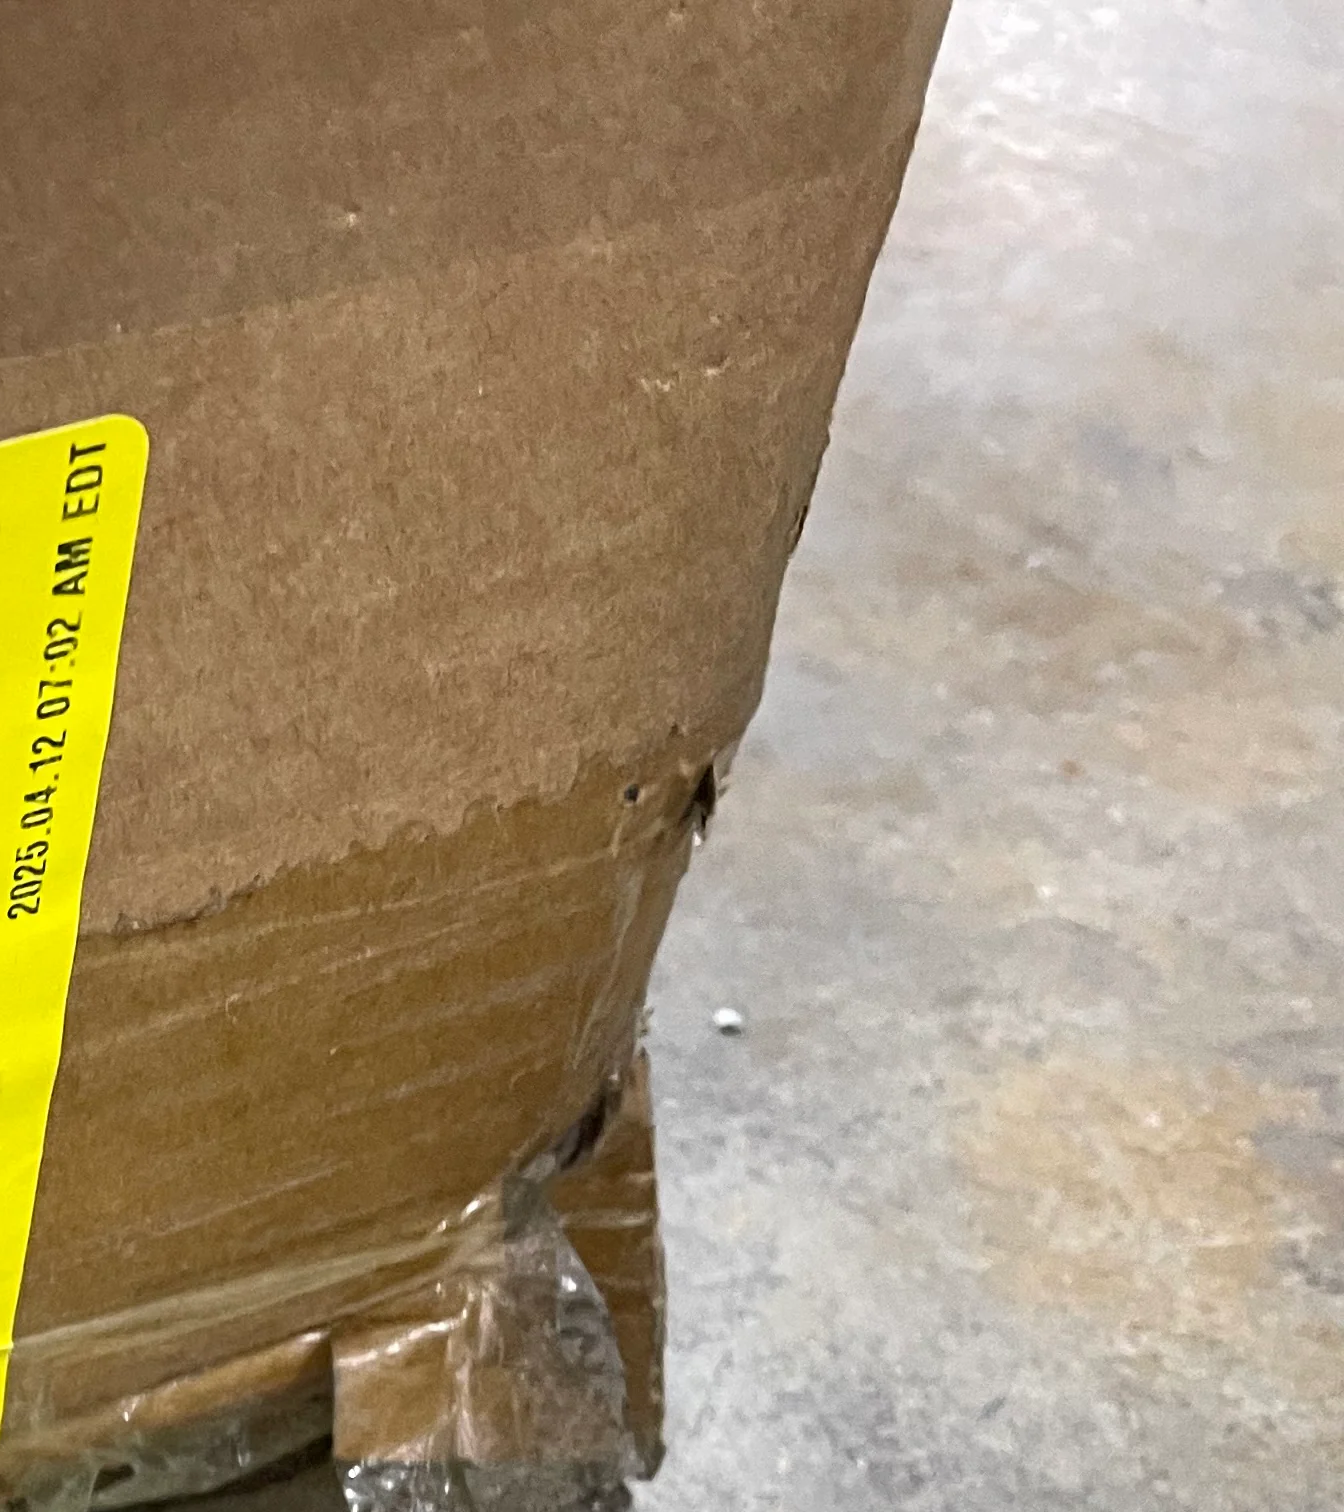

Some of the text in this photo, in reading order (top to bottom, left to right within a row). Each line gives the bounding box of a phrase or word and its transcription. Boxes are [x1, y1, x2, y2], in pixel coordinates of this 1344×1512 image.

[6, 442, 109, 921] 2025.04.12 07:02 AM EDT
